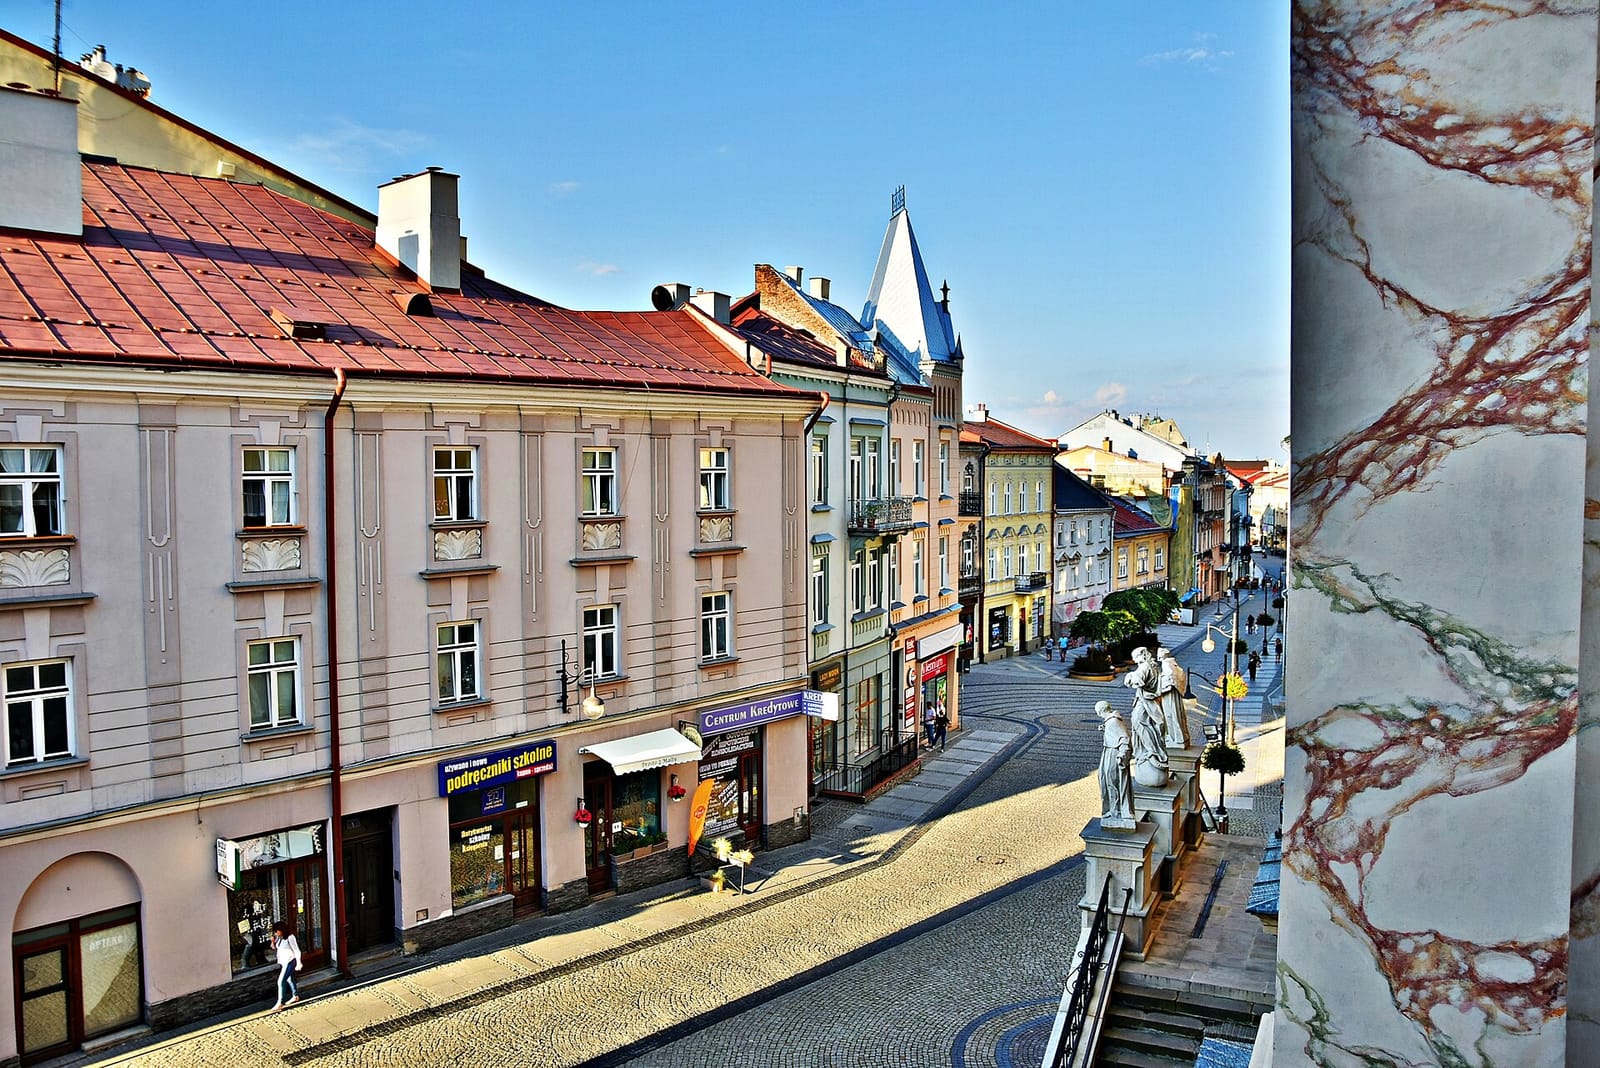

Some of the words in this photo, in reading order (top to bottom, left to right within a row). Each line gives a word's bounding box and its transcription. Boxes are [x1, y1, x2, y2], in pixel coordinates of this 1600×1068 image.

[704, 710, 747, 728] CENTRUM
[444, 761, 469, 773] używane
[473, 757, 488, 767] nowe
[447, 755, 512, 794] podręczniki
[513, 745, 553, 769] szkolne
